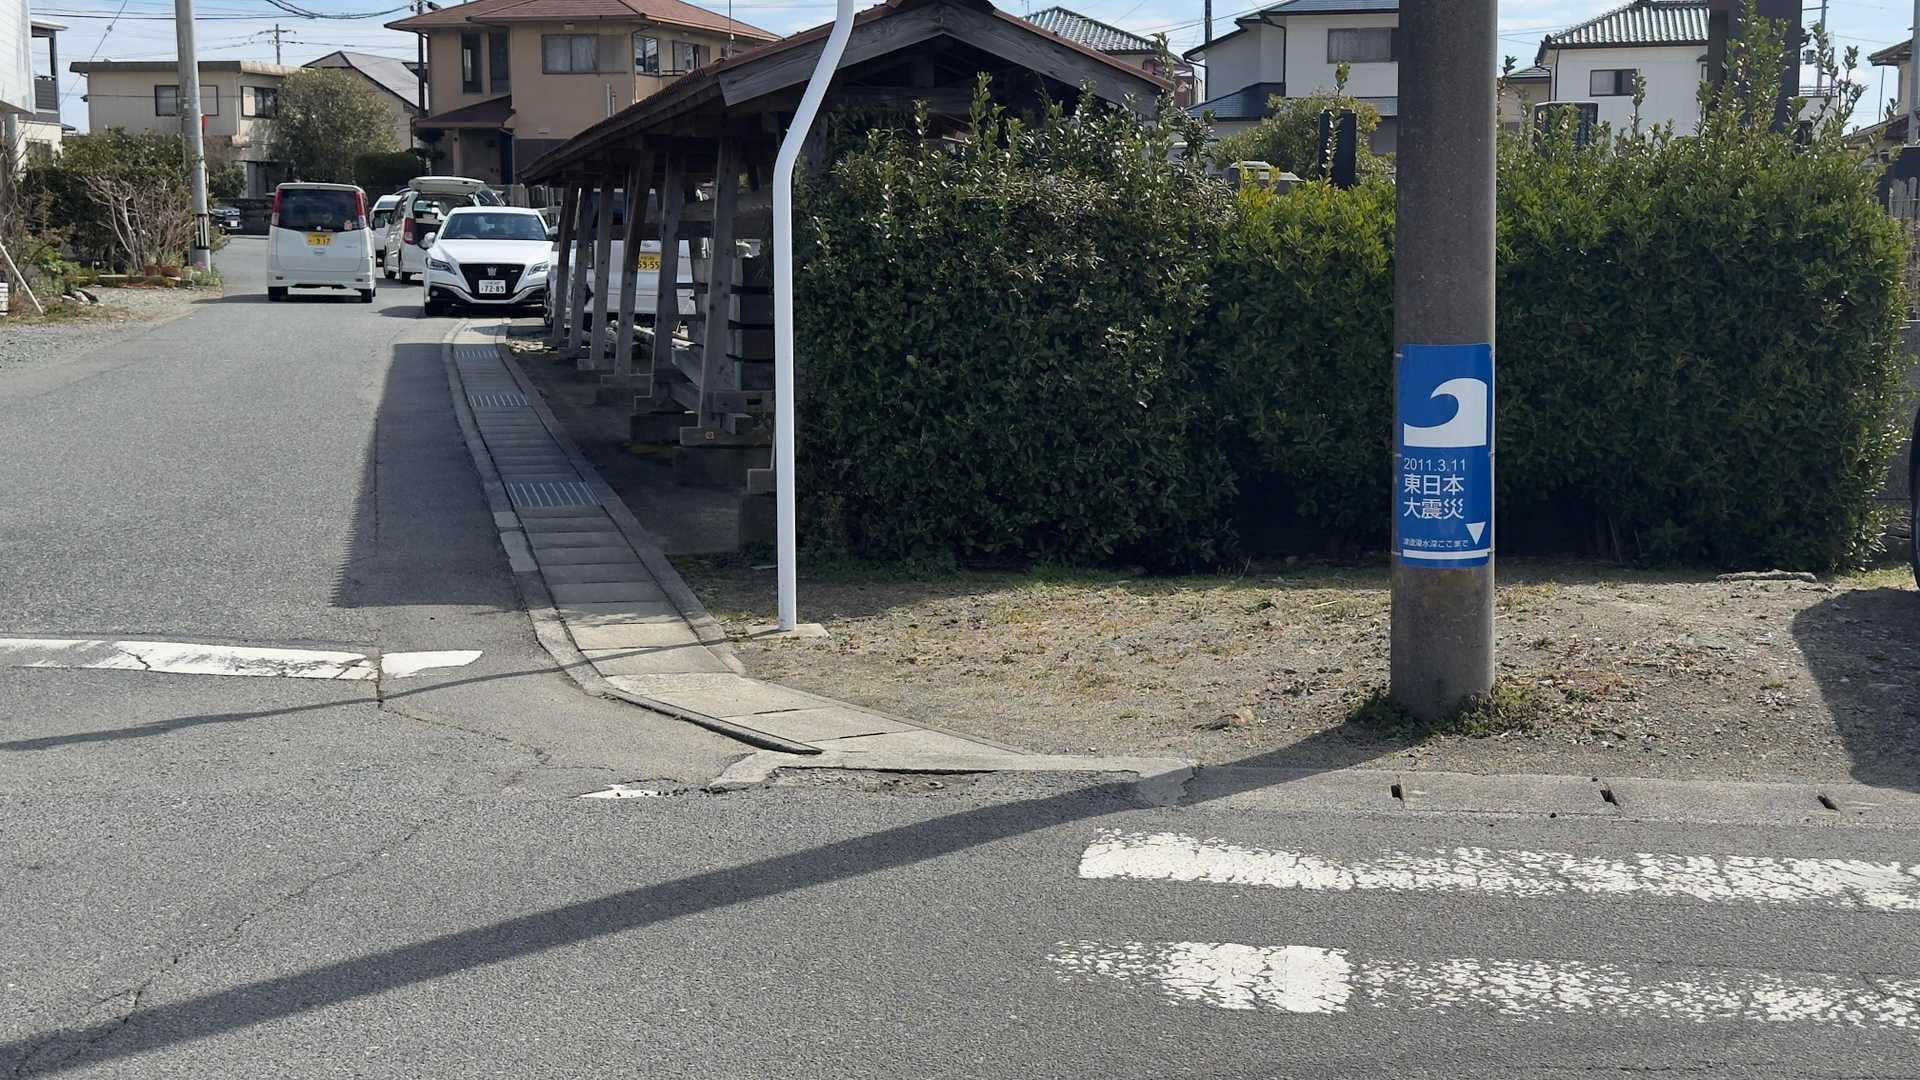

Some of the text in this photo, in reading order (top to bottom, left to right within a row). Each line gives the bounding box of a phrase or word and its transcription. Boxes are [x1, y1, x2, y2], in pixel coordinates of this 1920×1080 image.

[1403, 457, 1466, 472] 2011.3.11
[1403, 473, 1465, 496] 東日本
[1403, 497, 1465, 520] 大震災
